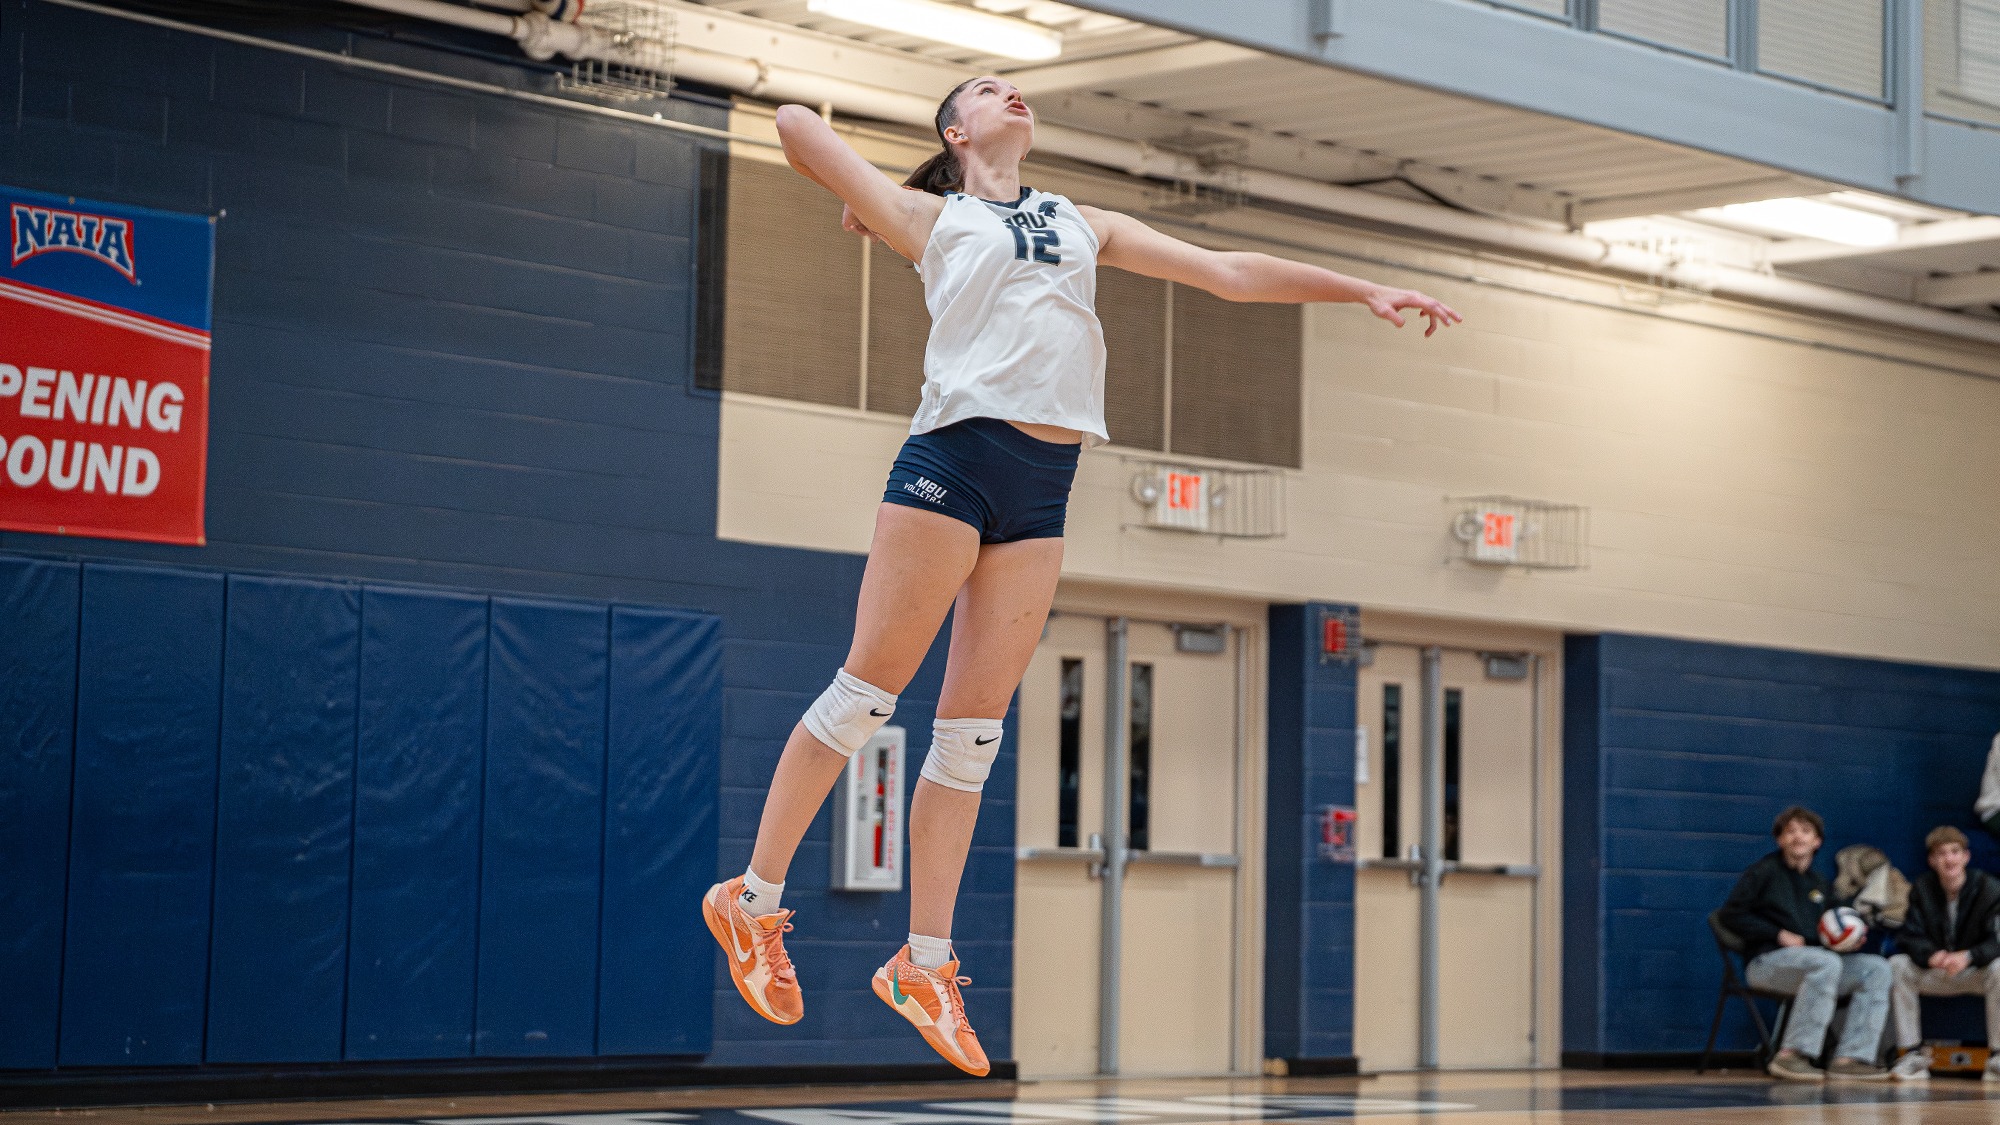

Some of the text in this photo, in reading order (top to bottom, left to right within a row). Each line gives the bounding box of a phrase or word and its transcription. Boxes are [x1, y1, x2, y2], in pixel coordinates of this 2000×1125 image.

[12, 204, 134, 280] NAIA
[1006, 224, 1061, 266] 12
[0, 363, 185, 433] PENING
[915, 476, 948, 499] MBU
[1168, 472, 1201, 511] EXIT
[1484, 512, 1515, 548] EXIT
